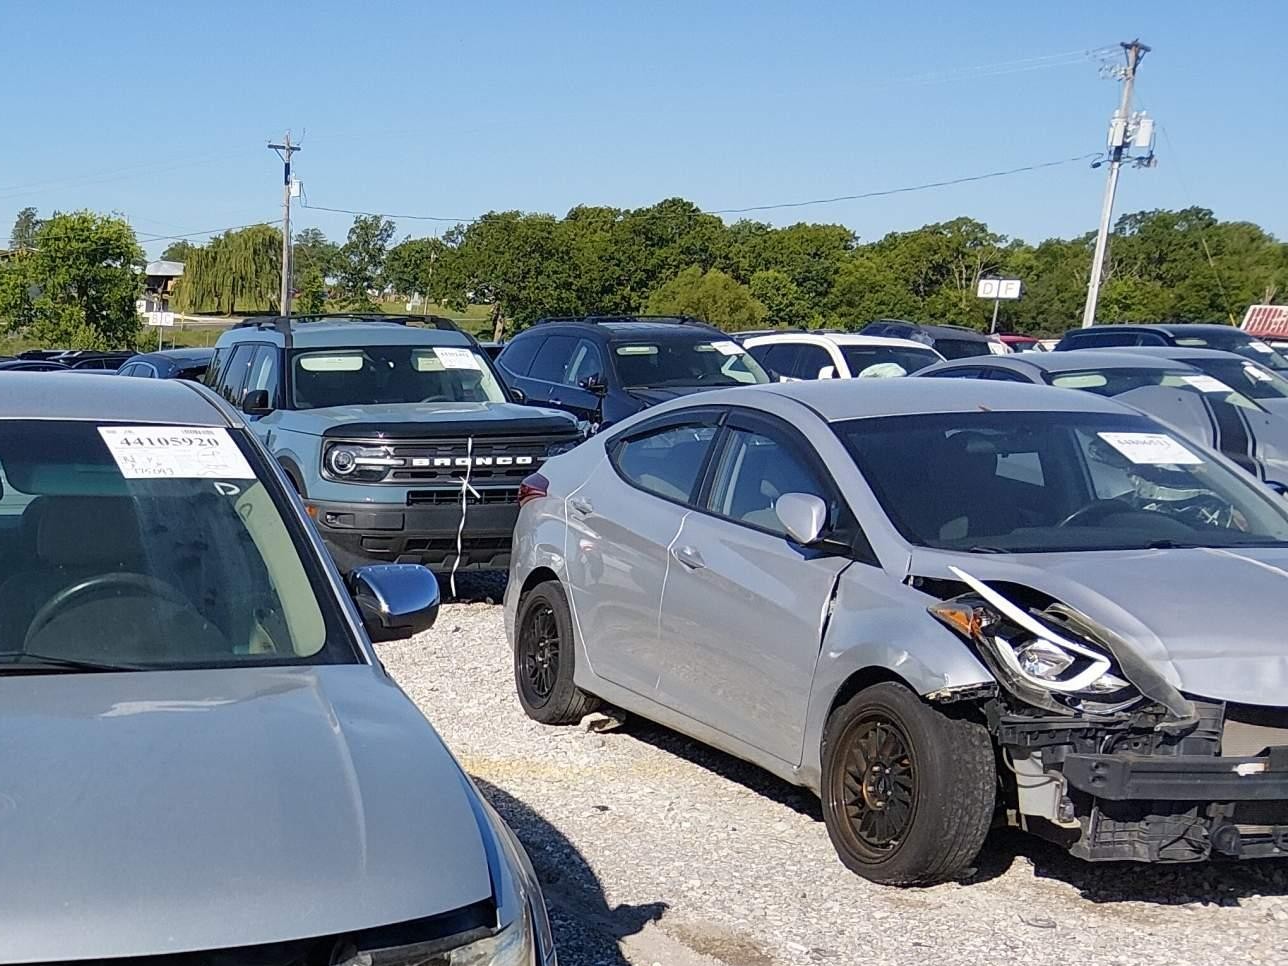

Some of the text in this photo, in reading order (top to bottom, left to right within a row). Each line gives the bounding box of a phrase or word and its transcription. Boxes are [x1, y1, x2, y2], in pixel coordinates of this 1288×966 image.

[982, 282, 1016, 296] D F
[120, 437, 220, 447] 44105920
[412, 456, 533, 466] BRONCO
